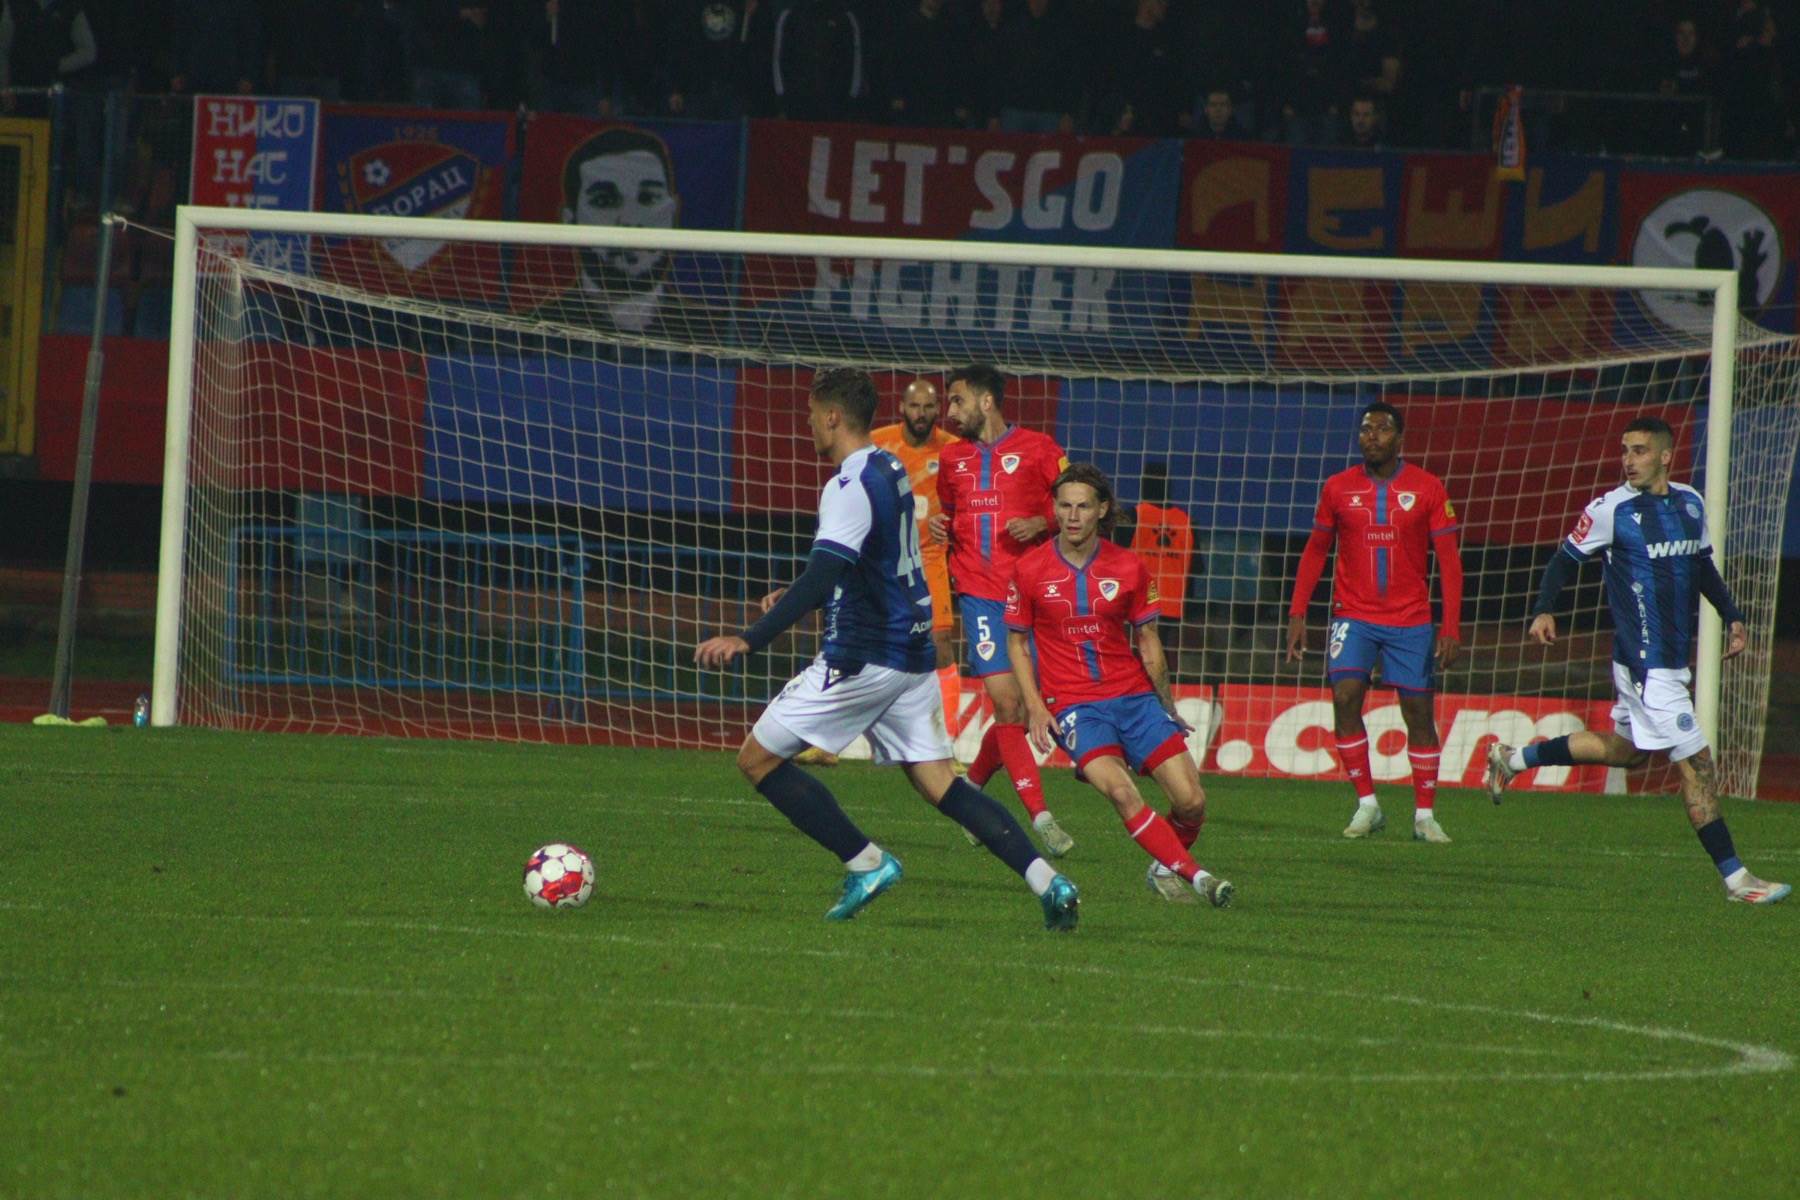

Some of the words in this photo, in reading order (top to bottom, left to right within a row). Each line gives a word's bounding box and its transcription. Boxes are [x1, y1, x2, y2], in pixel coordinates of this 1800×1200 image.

[207, 103, 305, 138] НИКО
[212, 149, 289, 185] НАС
[977, 616, 991, 642] 5
[1330, 622, 1349, 643] 24
